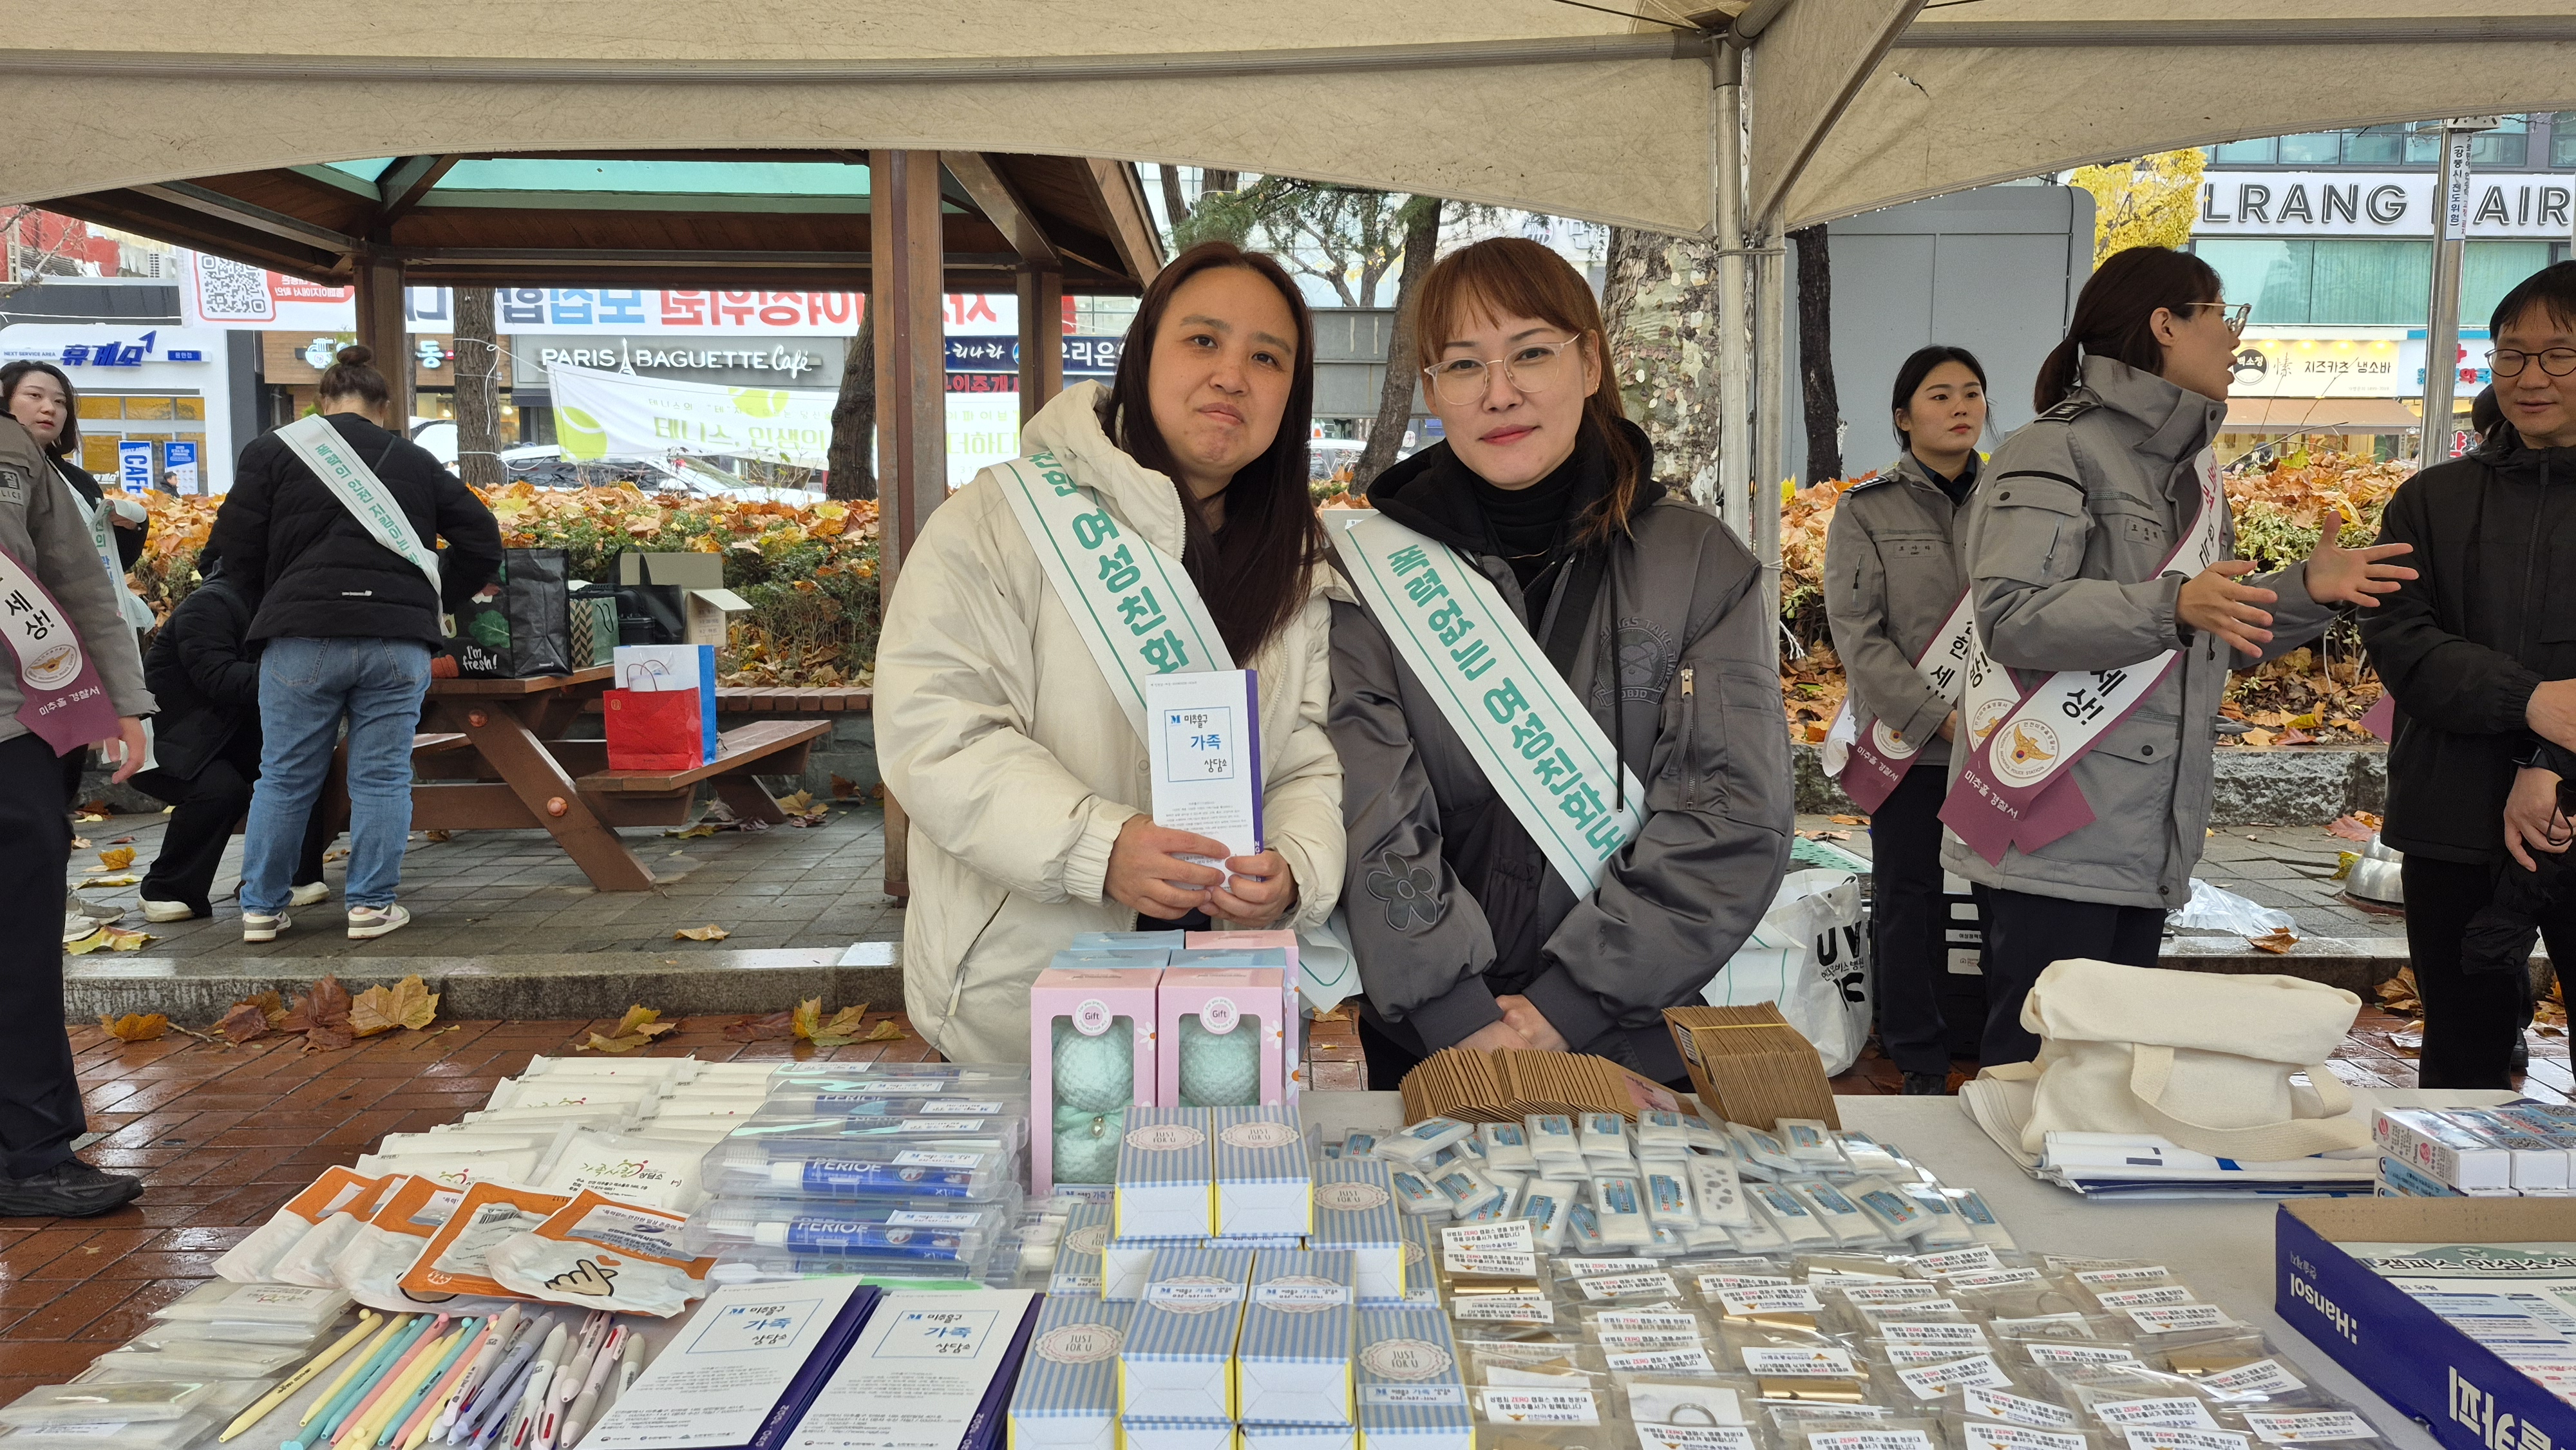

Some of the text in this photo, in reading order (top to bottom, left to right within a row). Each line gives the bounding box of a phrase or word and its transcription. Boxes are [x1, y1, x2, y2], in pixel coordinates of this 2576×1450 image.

[2203, 182, 2573, 227] LRANG AIR
[60, 341, 146, 366] 휴게소
[542, 344, 812, 380] PARIS BAGUETTE Café
[1063, 342, 1125, 367] 리은
[2304, 360, 2391, 373] 치즈카츠 냉소바
[649, 398, 694, 412] 테니스의
[654, 416, 826, 451] 테니스, 인생의
[348, 478, 374, 504] 안전
[368, 503, 410, 551] 지킴이는
[5, 588, 55, 641] 세상!
[1387, 543, 1497, 682] 폭력없는
[1644, 619, 1674, 647] TAKE
[466, 646, 482, 660] I'm
[462, 653, 498, 673] fresh!
[68, 685, 101, 704] 경찰서
[1184, 714, 1208, 728] 미추홀구
[1190, 734, 1222, 751] 가족
[1204, 758, 1227, 773] 상담소
[1857, 745, 1899, 782] 미추홀 경찰서
[2026, 766, 2045, 775] STATION
[1964, 769, 2019, 820] 미추홀 경찰서
[749, 1305, 786, 1316] 미추홀구
[2290, 1273, 2350, 1341] Hansol
[743, 1317, 792, 1330] 가족
[927, 1313, 963, 1324] 미추홀구
[752, 1333, 788, 1346] 상담소
[923, 1326, 972, 1338] 가족
[1070, 1334, 1092, 1344] JUST
[935, 1342, 971, 1353] 상담소
[1392, 1350, 1414, 1359] JUST
